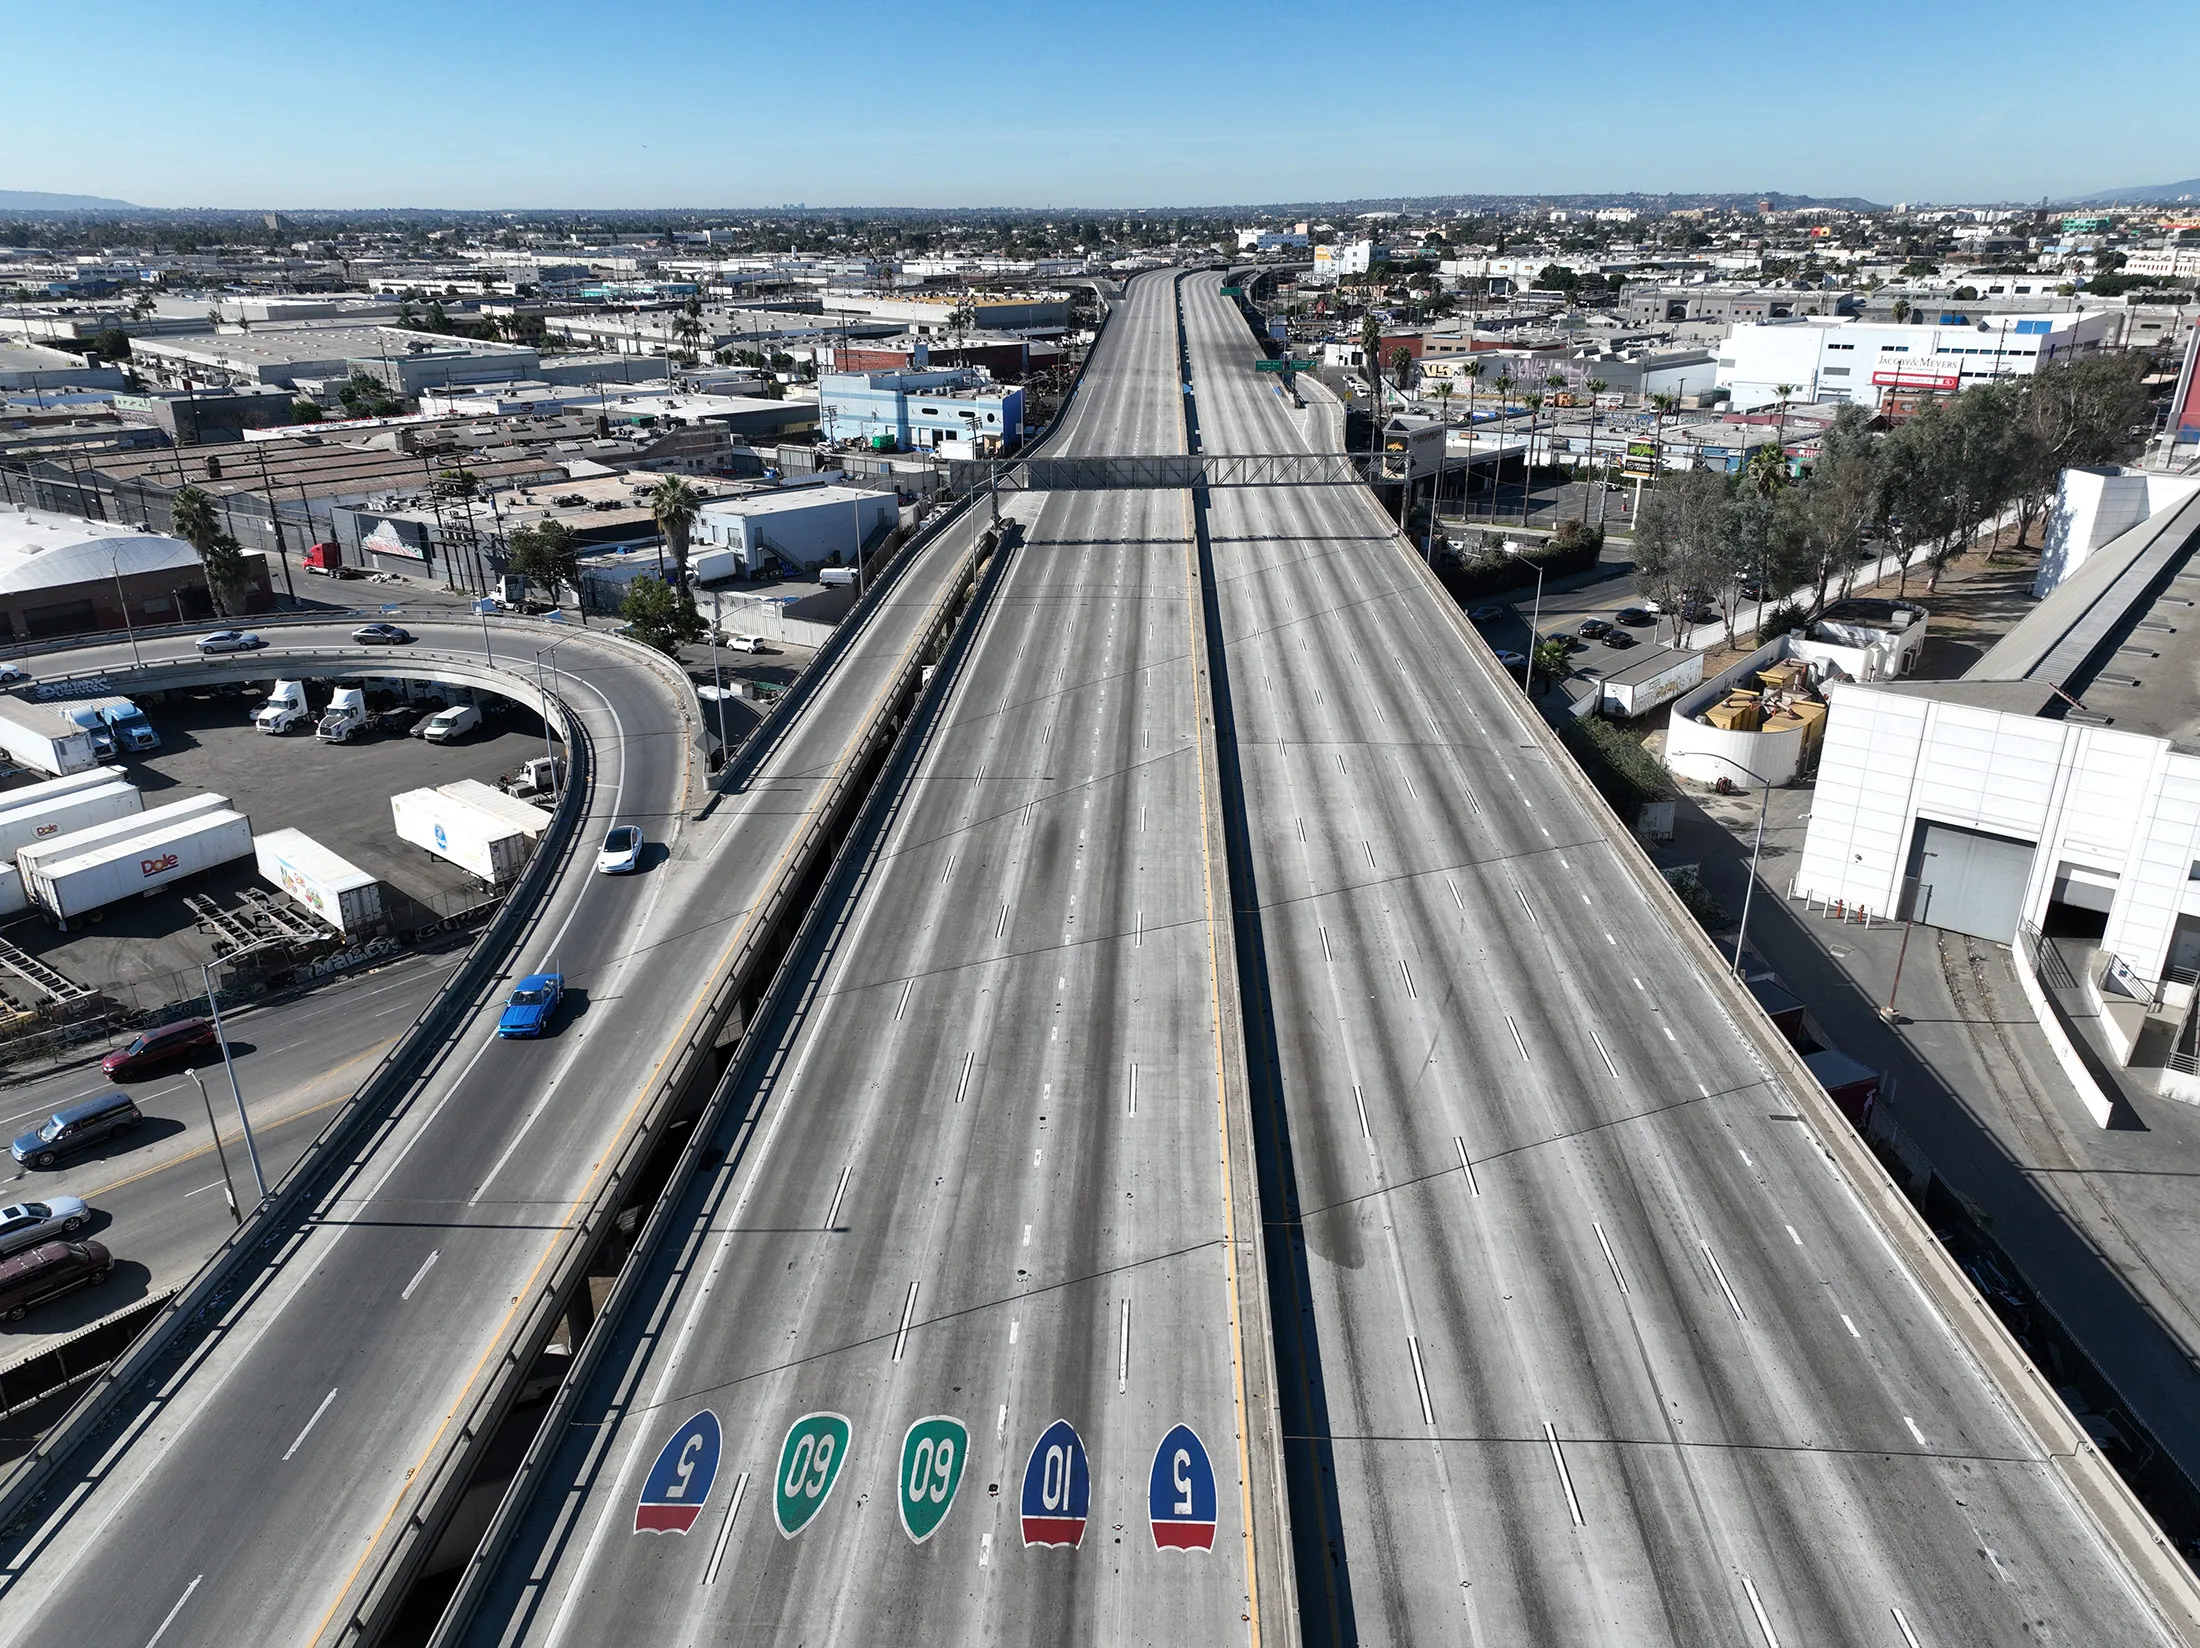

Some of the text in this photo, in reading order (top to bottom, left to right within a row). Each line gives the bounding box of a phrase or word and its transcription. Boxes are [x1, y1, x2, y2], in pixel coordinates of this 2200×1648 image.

[36, 823, 58, 835] Dole
[140, 853, 179, 874] Dole
[665, 1433, 703, 1498] 5
[784, 1433, 835, 1498] 60
[908, 1437, 955, 1503] 60
[1042, 1444, 1073, 1511] 10
[1173, 1448, 1193, 1515] 5
